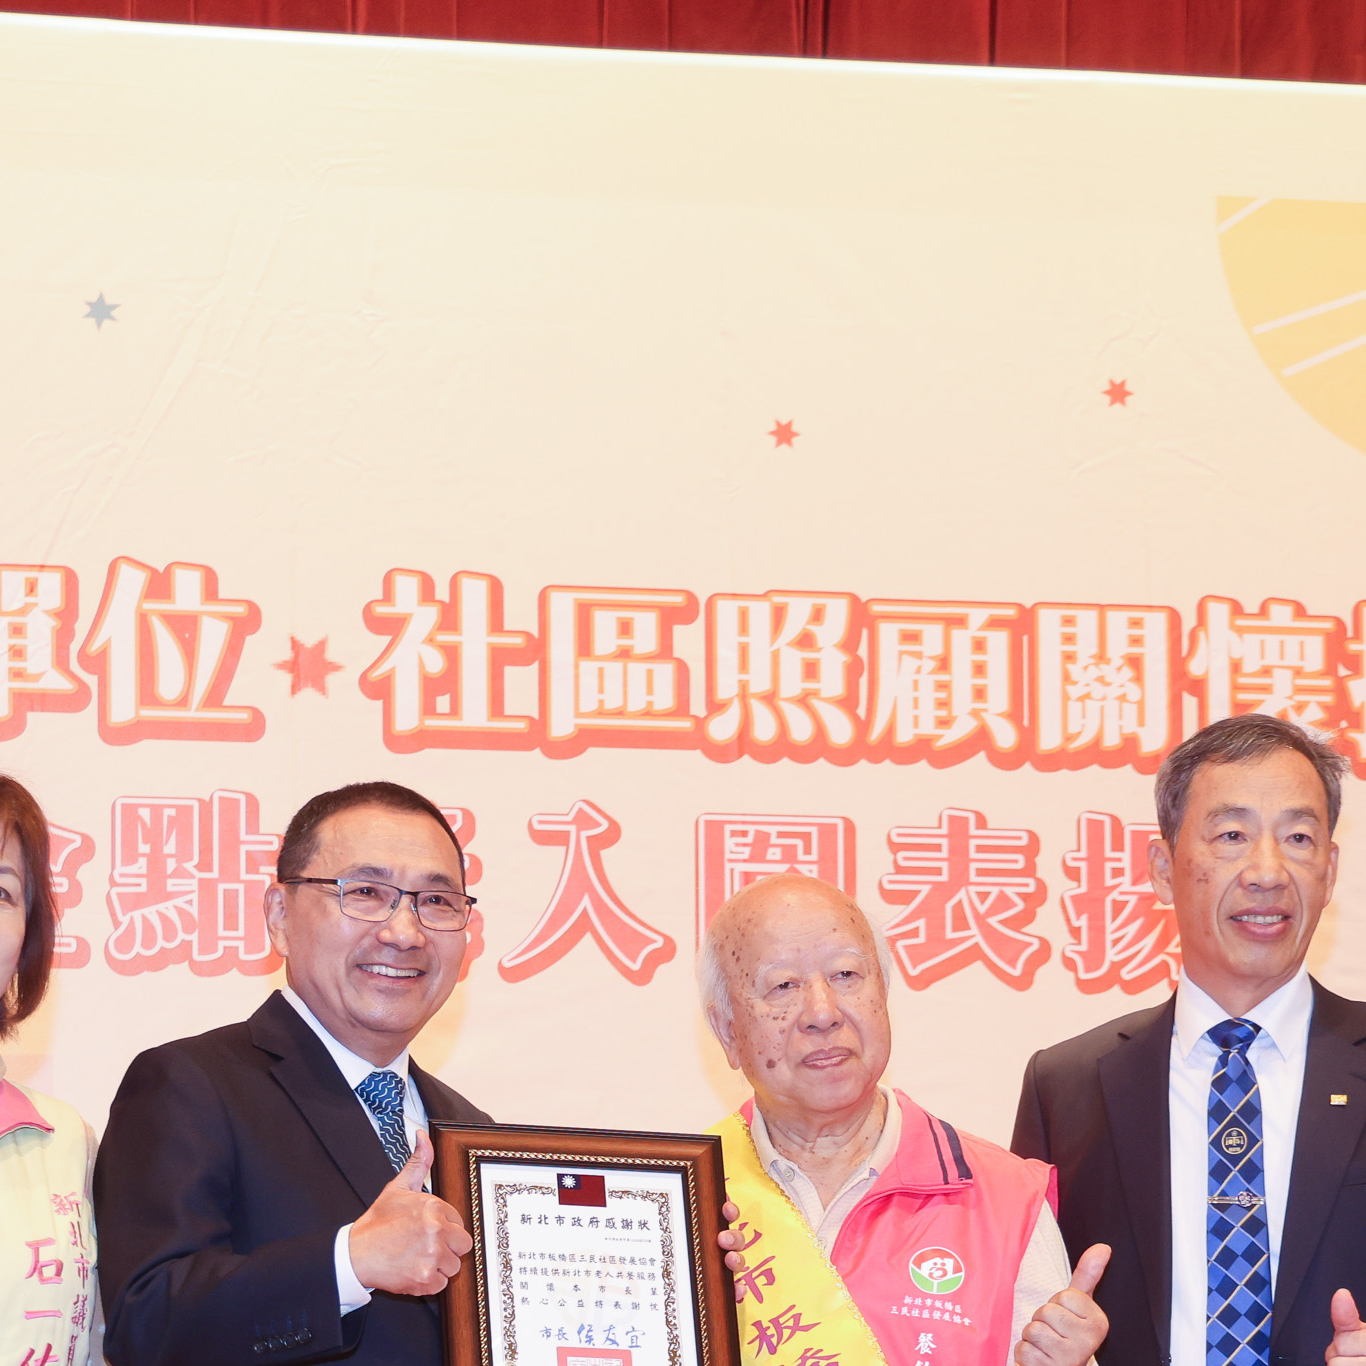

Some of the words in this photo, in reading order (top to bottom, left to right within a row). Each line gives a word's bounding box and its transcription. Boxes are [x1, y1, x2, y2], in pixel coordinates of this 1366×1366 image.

[520, 1213, 651, 1231] 新北市政府感謝狀
[518, 1251, 657, 1267] 新北市板橋區三民社區發展協會
[519, 1266, 657, 1282] 持續提供新北市老人共餐服務
[539, 1326, 569, 1341] 市長
[577, 1323, 646, 1348] 侯友宜
